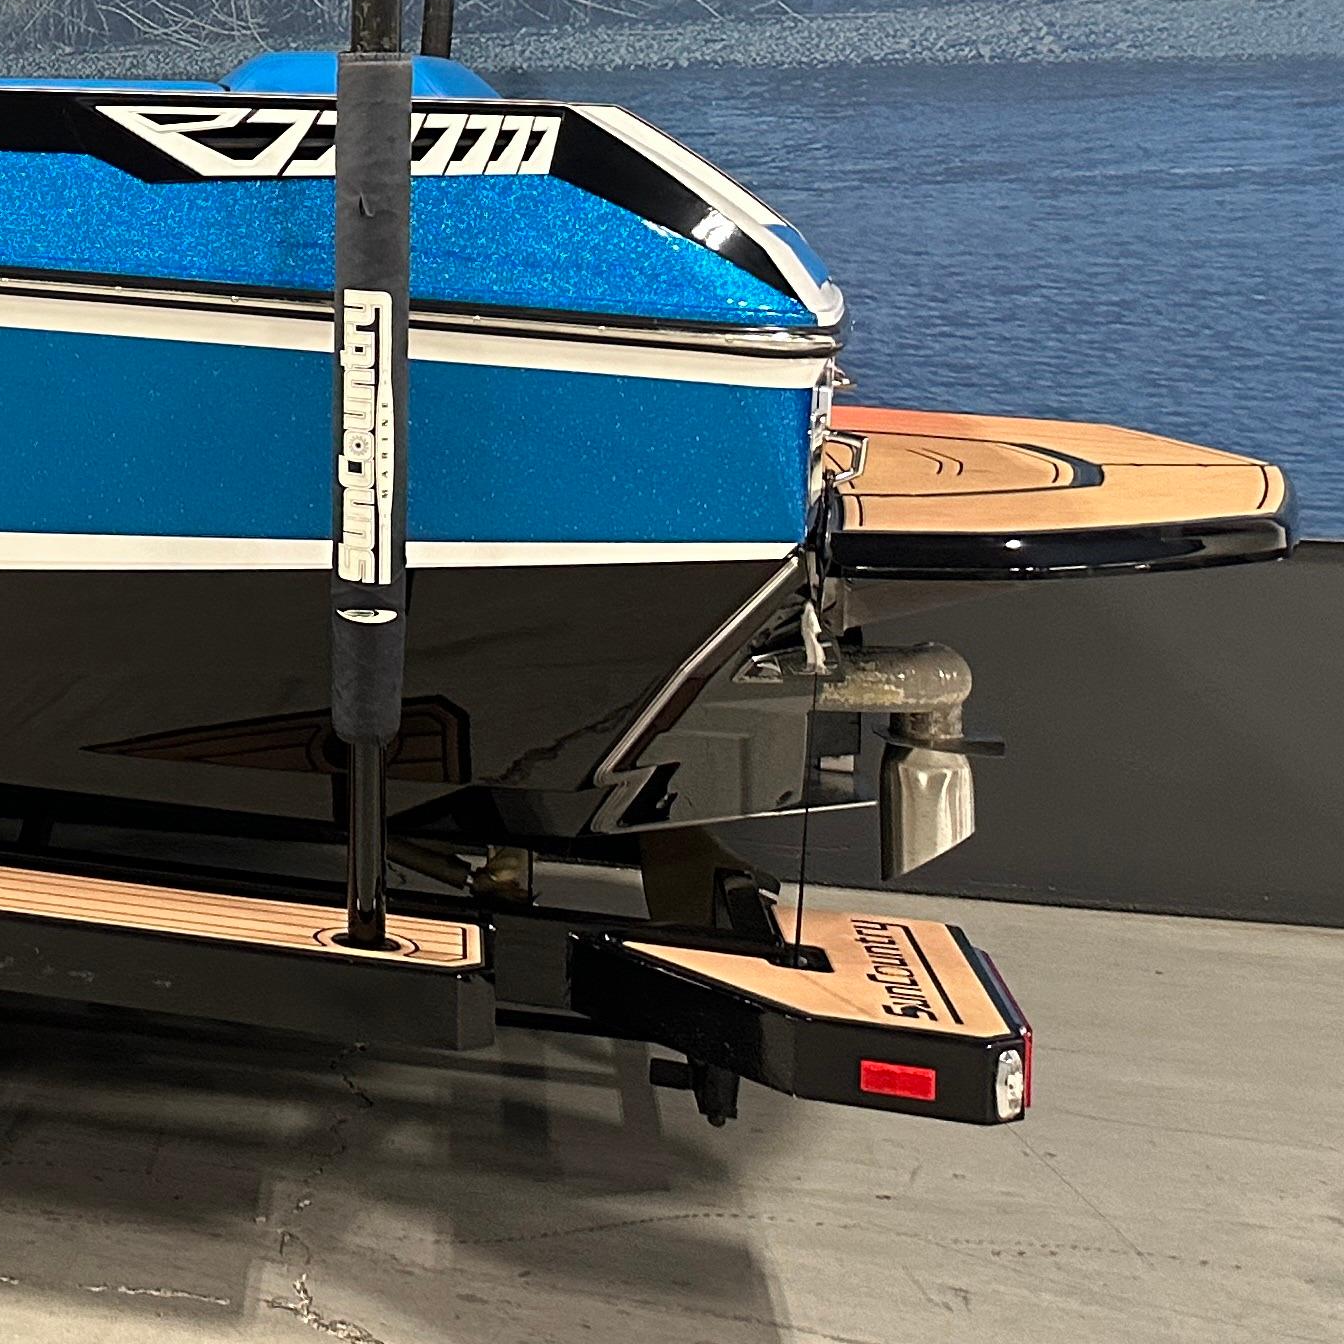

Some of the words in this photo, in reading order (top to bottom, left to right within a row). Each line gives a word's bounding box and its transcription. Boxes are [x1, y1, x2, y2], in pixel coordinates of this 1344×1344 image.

[338, 288, 380, 584] SunCountry
[380, 401, 390, 499] MARINE
[850, 918, 939, 1023] SunCountry
